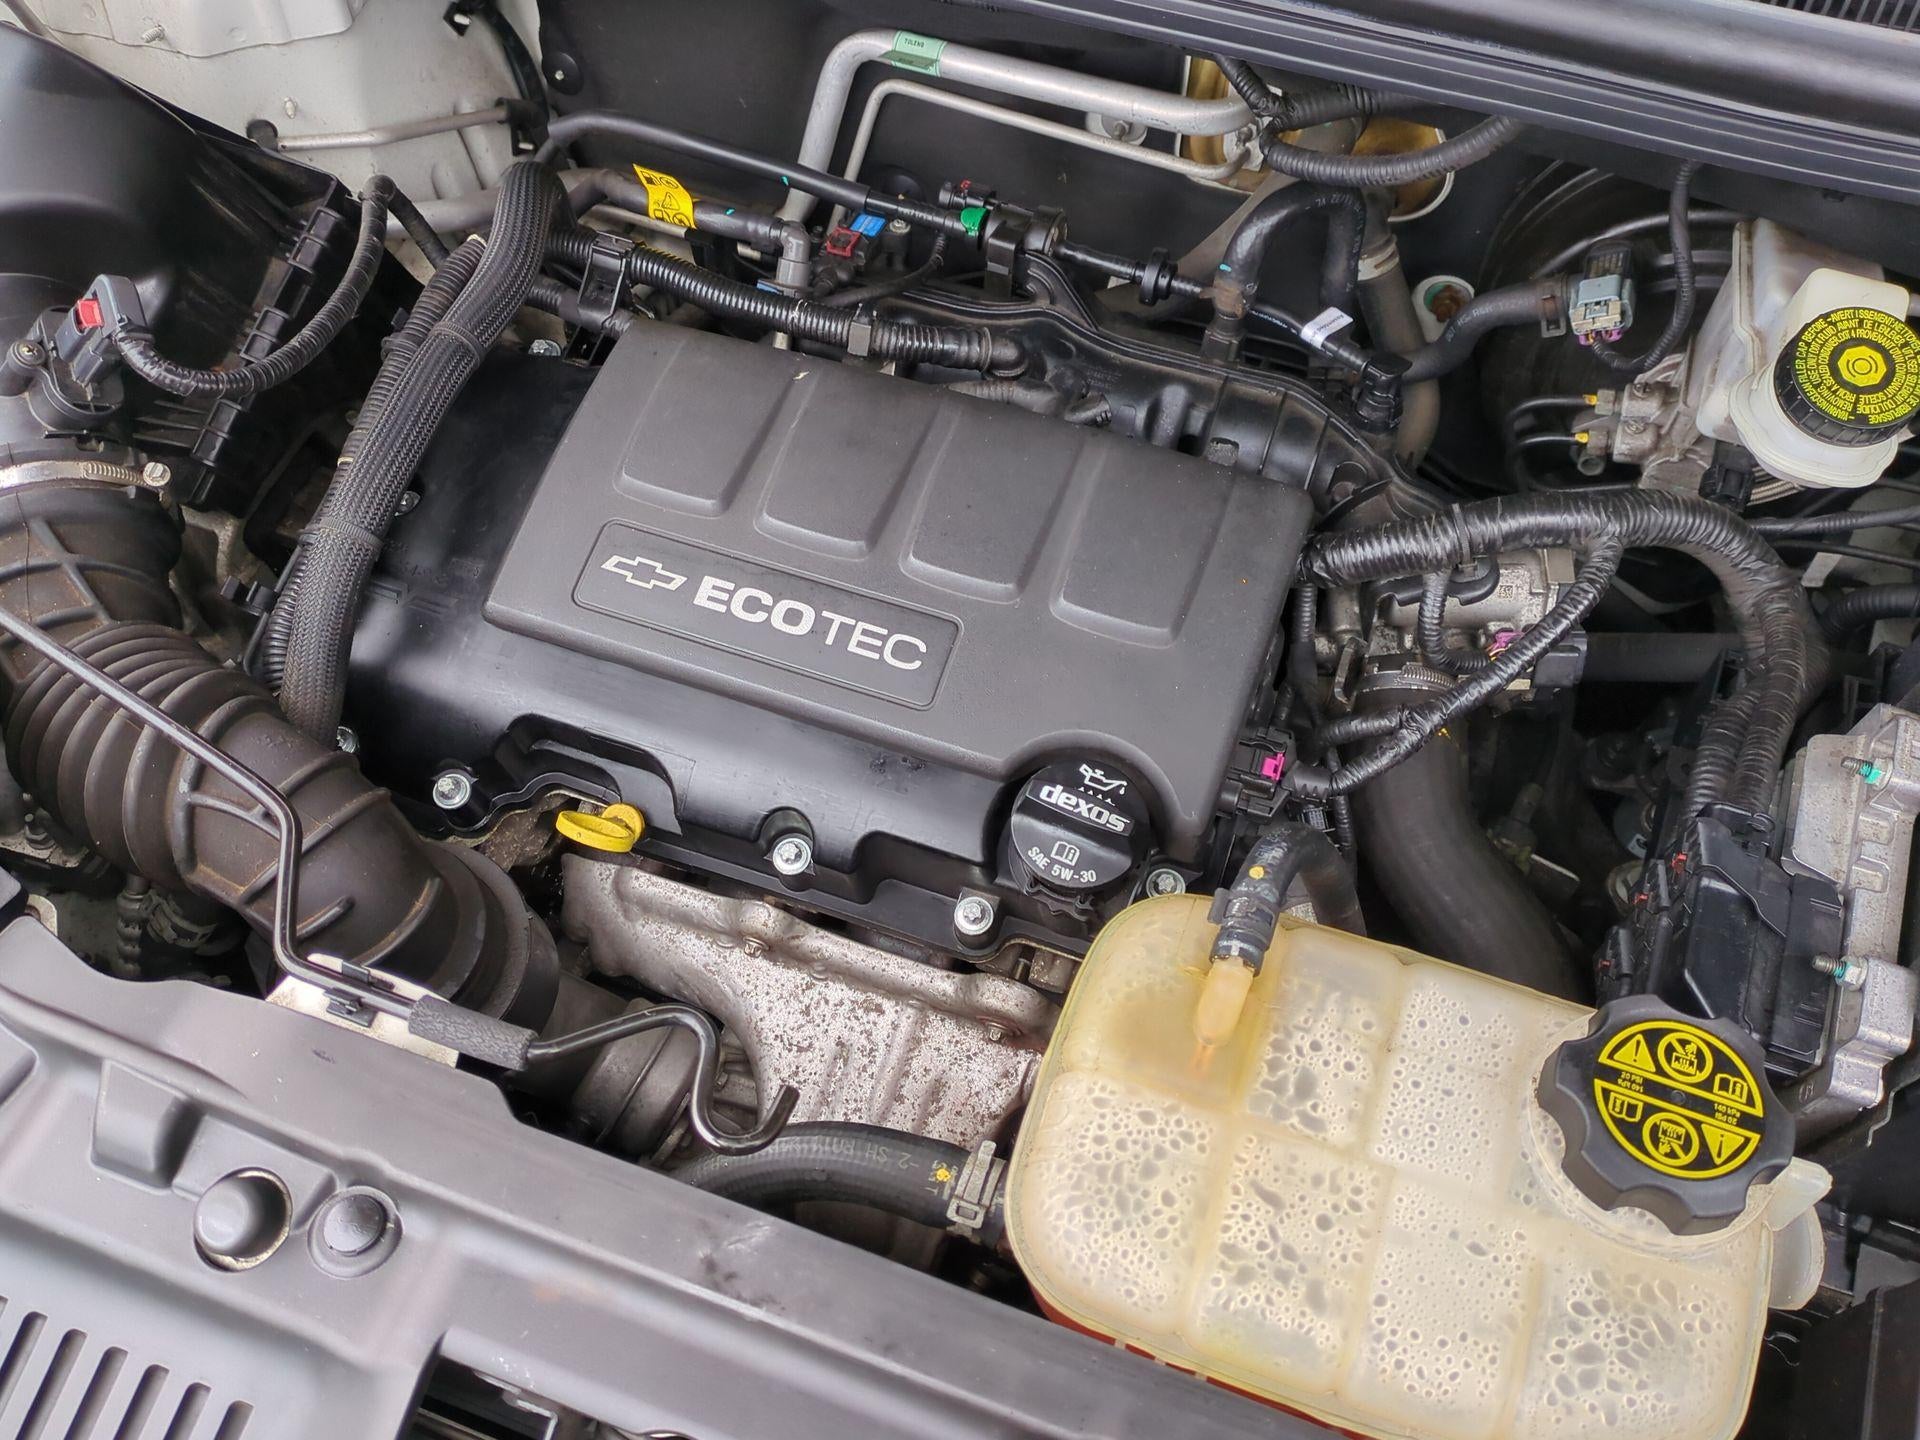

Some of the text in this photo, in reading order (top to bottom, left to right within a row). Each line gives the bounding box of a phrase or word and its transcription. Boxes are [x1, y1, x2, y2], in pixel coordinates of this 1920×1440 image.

[1837, 319, 1858, 330] AVANT
[1863, 319, 1873, 329] DE
[1796, 341, 1807, 357] CAP
[1802, 319, 1827, 342] BEFORE
[1817, 325, 1836, 341] FLUID
[1809, 341, 1820, 353] DOT
[1807, 370, 1821, 384] USE
[1819, 365, 1834, 386] SEALED
[1830, 383, 1840, 391] A
[1836, 388, 1856, 402] FROM
[693, 575, 927, 670] ECOTEC
[1040, 784, 1130, 832] dexos
[1028, 846, 1097, 883] SAE 5W-30
[1621, 1071, 1643, 1084] 20 PSI
[1714, 1103, 1741, 1118] 140 kPa
